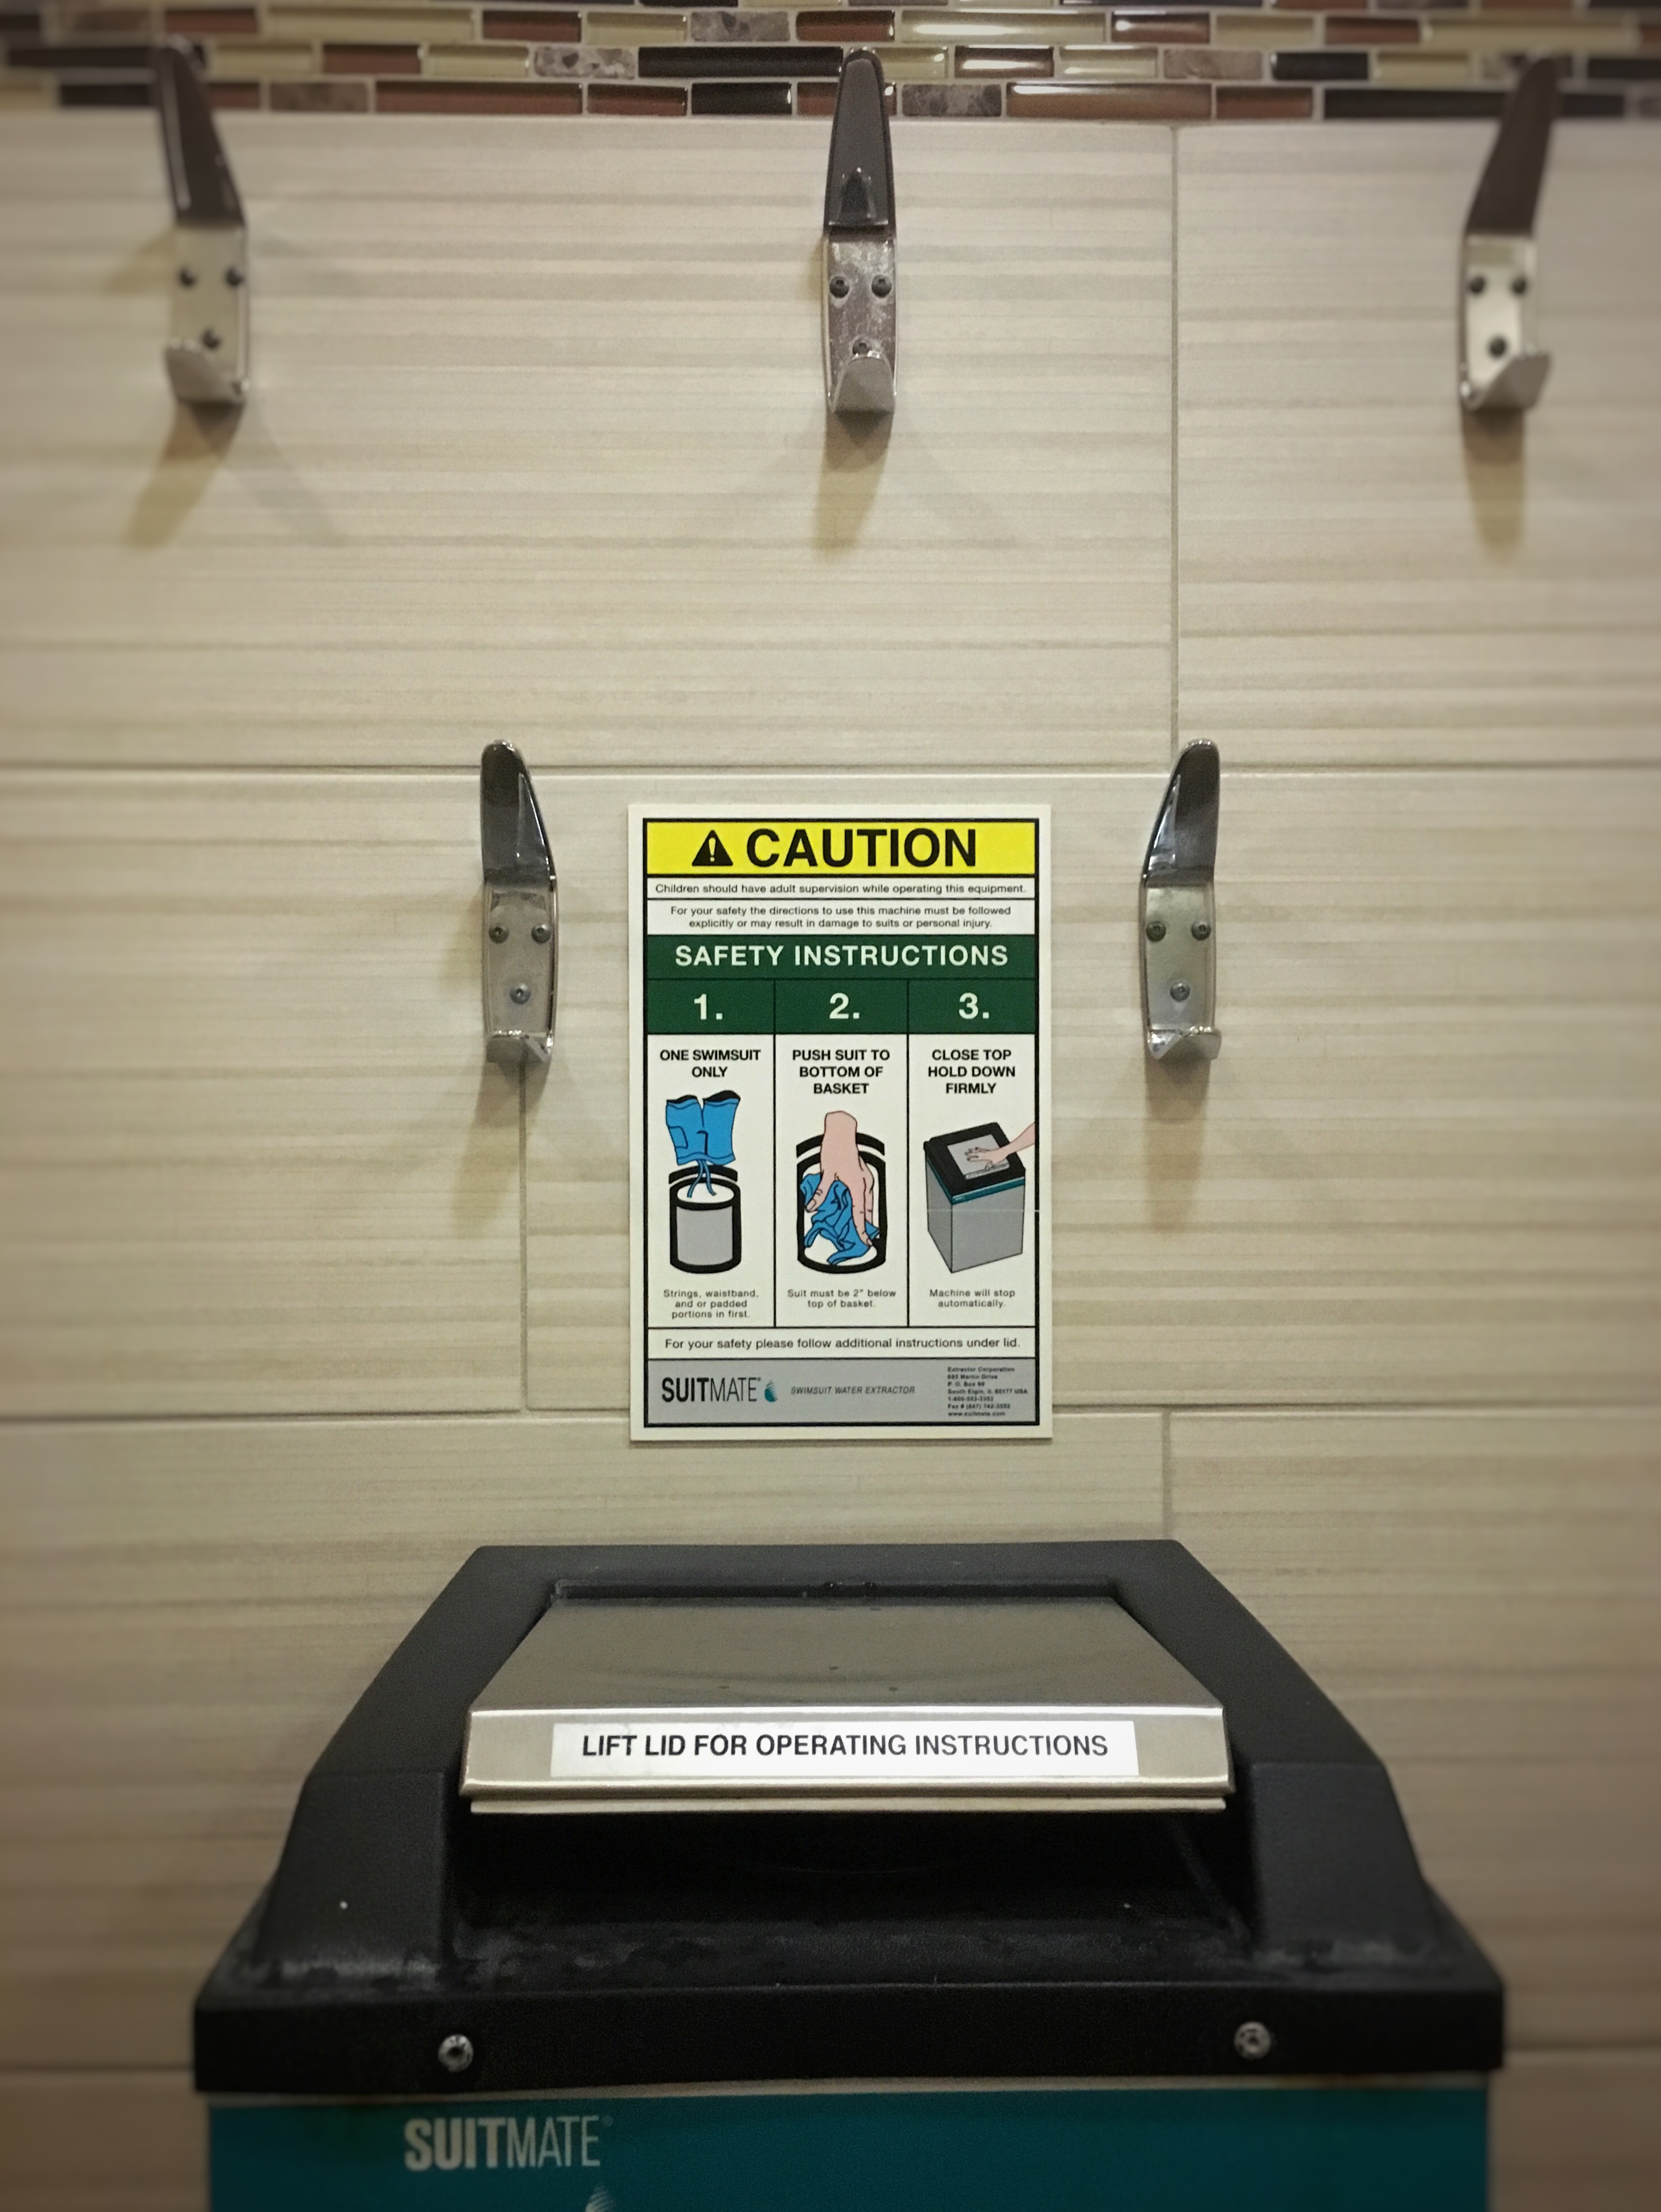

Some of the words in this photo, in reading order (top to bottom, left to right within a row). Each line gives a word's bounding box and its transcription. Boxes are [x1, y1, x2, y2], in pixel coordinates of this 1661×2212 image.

[746, 828, 976, 868] CAUTION
[655, 883, 700, 893] Children
[703, 884, 738, 893] should
[741, 884, 766, 893] have
[769, 884, 796, 893] adult
[799, 884, 859, 895] supervision
[862, 884, 889, 893] while
[892, 884, 942, 895] operating
[946, 884, 964, 893] this
[968, 884, 1027, 895] equipment.
[671, 906, 688, 915] For
[690, 908, 713, 917] your
[716, 906, 747, 917] safety
[750, 906, 766, 915] the
[769, 906, 819, 915] directions
[822, 906, 833, 915] to
[857, 906, 875, 915] this
[878, 906, 921, 915] machine
[924, 906, 949, 915] must
[952, 906, 965, 915] be
[968, 906, 1011, 915] followed
[689, 919, 734, 930] explicitly
[751, 920, 772, 930] may
[775, 919, 803, 928] result
[806, 919, 815, 927] in
[818, 919, 859, 930] damage
[862, 919, 873, 927] to
[875, 919, 900, 927] suits
[916, 919, 960, 929] personal
[963, 919, 993, 930] injury.
[675, 945, 784, 967] SAFETY
[795, 944, 1008, 967] INSTRUCTIONS
[694, 993, 723, 1020] 1.
[829, 992, 860, 1019] 2.
[959, 992, 989, 1020] 3.
[659, 1049, 689, 1061] ONE
[692, 1049, 761, 1061] SWIMSUIT
[792, 1049, 831, 1061] PUSH
[835, 1049, 867, 1061] SUIT
[870, 1049, 891, 1061] TO
[931, 1049, 979, 1061] CLOSE
[982, 1049, 1012, 1061] TOP
[691, 1066, 728, 1078] ONLY
[799, 1066, 860, 1078] BOTTOM
[864, 1066, 883, 1078] OF
[928, 1066, 968, 1078] HOLD
[971, 1066, 1015, 1077] DOWN
[813, 1083, 870, 1095] BASKET
[946, 1082, 997, 1094] FIRMLY
[663, 1289, 701, 1299] Strings,
[705, 1289, 759, 1299] waistband,
[787, 1289, 807, 1298] Suit
[837, 1289, 850, 1298] be
[853, 1289, 864, 1298] 2"
[867, 1289, 896, 1298] below
[929, 1289, 971, 1297] Machine
[974, 1289, 990, 1297] will
[994, 1289, 1015, 1298] stop
[675, 1300, 693, 1308] and
[710, 1299, 747, 1310] padded
[807, 1300, 824, 1310] top
[827, 1299, 837, 1308] of
[840, 1299, 876, 1308] basket.
[938, 1299, 1006, 1309] automatically.
[671, 1311, 713, 1320] portions
[728, 1310, 749, 1319] first.
[665, 1338, 684, 1349] For
[688, 1341, 714, 1351] your
[717, 1338, 752, 1350] safety
[756, 1338, 794, 1350] please
[797, 1338, 832, 1348] follow
[835, 1338, 892, 1348] additional
[896, 1338, 963, 1348] instructions
[967, 1338, 1000, 1347] under
[1003, 1337, 1020, 1347] lid.
[790, 1386, 832, 1395] SWIMSUIT
[834, 1385, 863, 1395] WATER
[865, 1385, 916, 1395] EXTRACTOR
[582, 1735, 638, 1757] LIFT
[645, 1735, 686, 1756] LID
[694, 1734, 747, 1756] FOR
[756, 1734, 906, 1756] OPERATING
[916, 1734, 1108, 1756] INSTRUCTIONS
